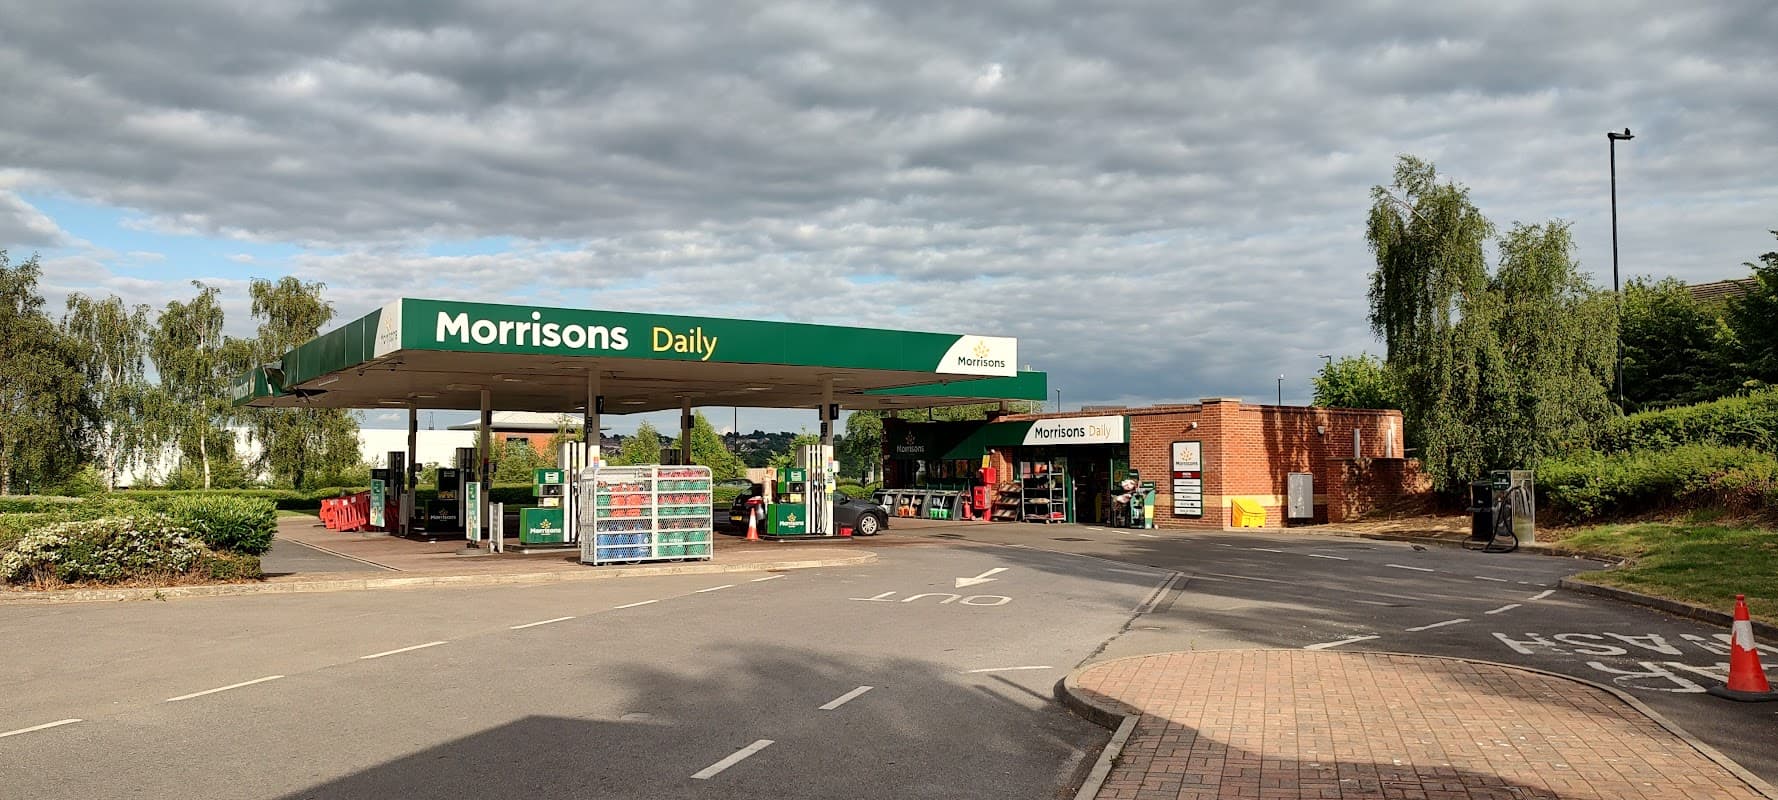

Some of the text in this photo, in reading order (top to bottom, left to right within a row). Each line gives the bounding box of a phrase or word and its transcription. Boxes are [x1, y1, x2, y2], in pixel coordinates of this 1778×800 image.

[436, 311, 717, 361] Morrisons Daily
[957, 356, 1006, 368] Morrisons
[1035, 424, 1111, 439] Morrisons Daily
[848, 591, 1013, 606] OUT
